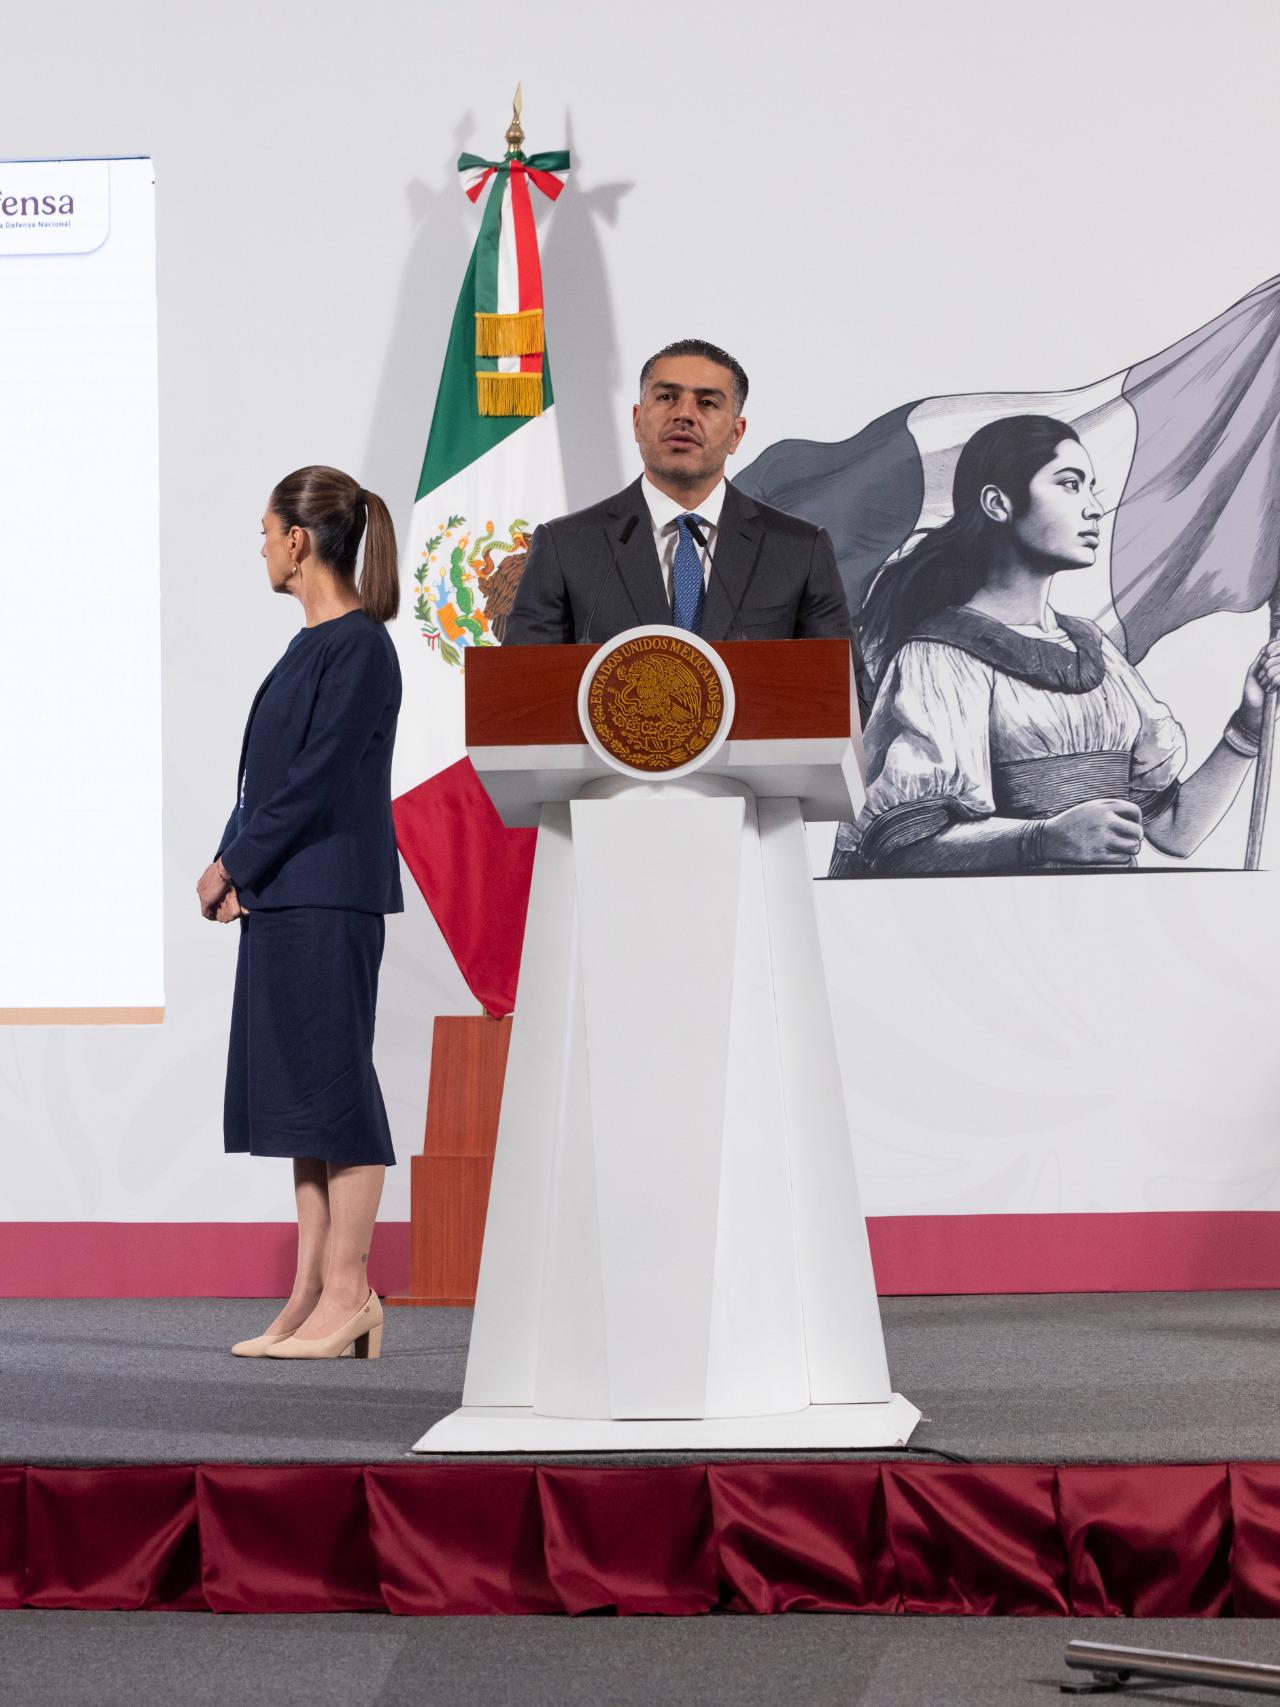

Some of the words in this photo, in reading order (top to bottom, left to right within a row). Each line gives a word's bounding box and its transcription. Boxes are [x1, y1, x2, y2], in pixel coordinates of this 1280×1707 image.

[38, 220, 72, 229] Nacional
[591, 653, 624, 705] ESTADOS
[622, 638, 669, 657] UNIDOS
[670, 639, 721, 701] MEXICANOS
